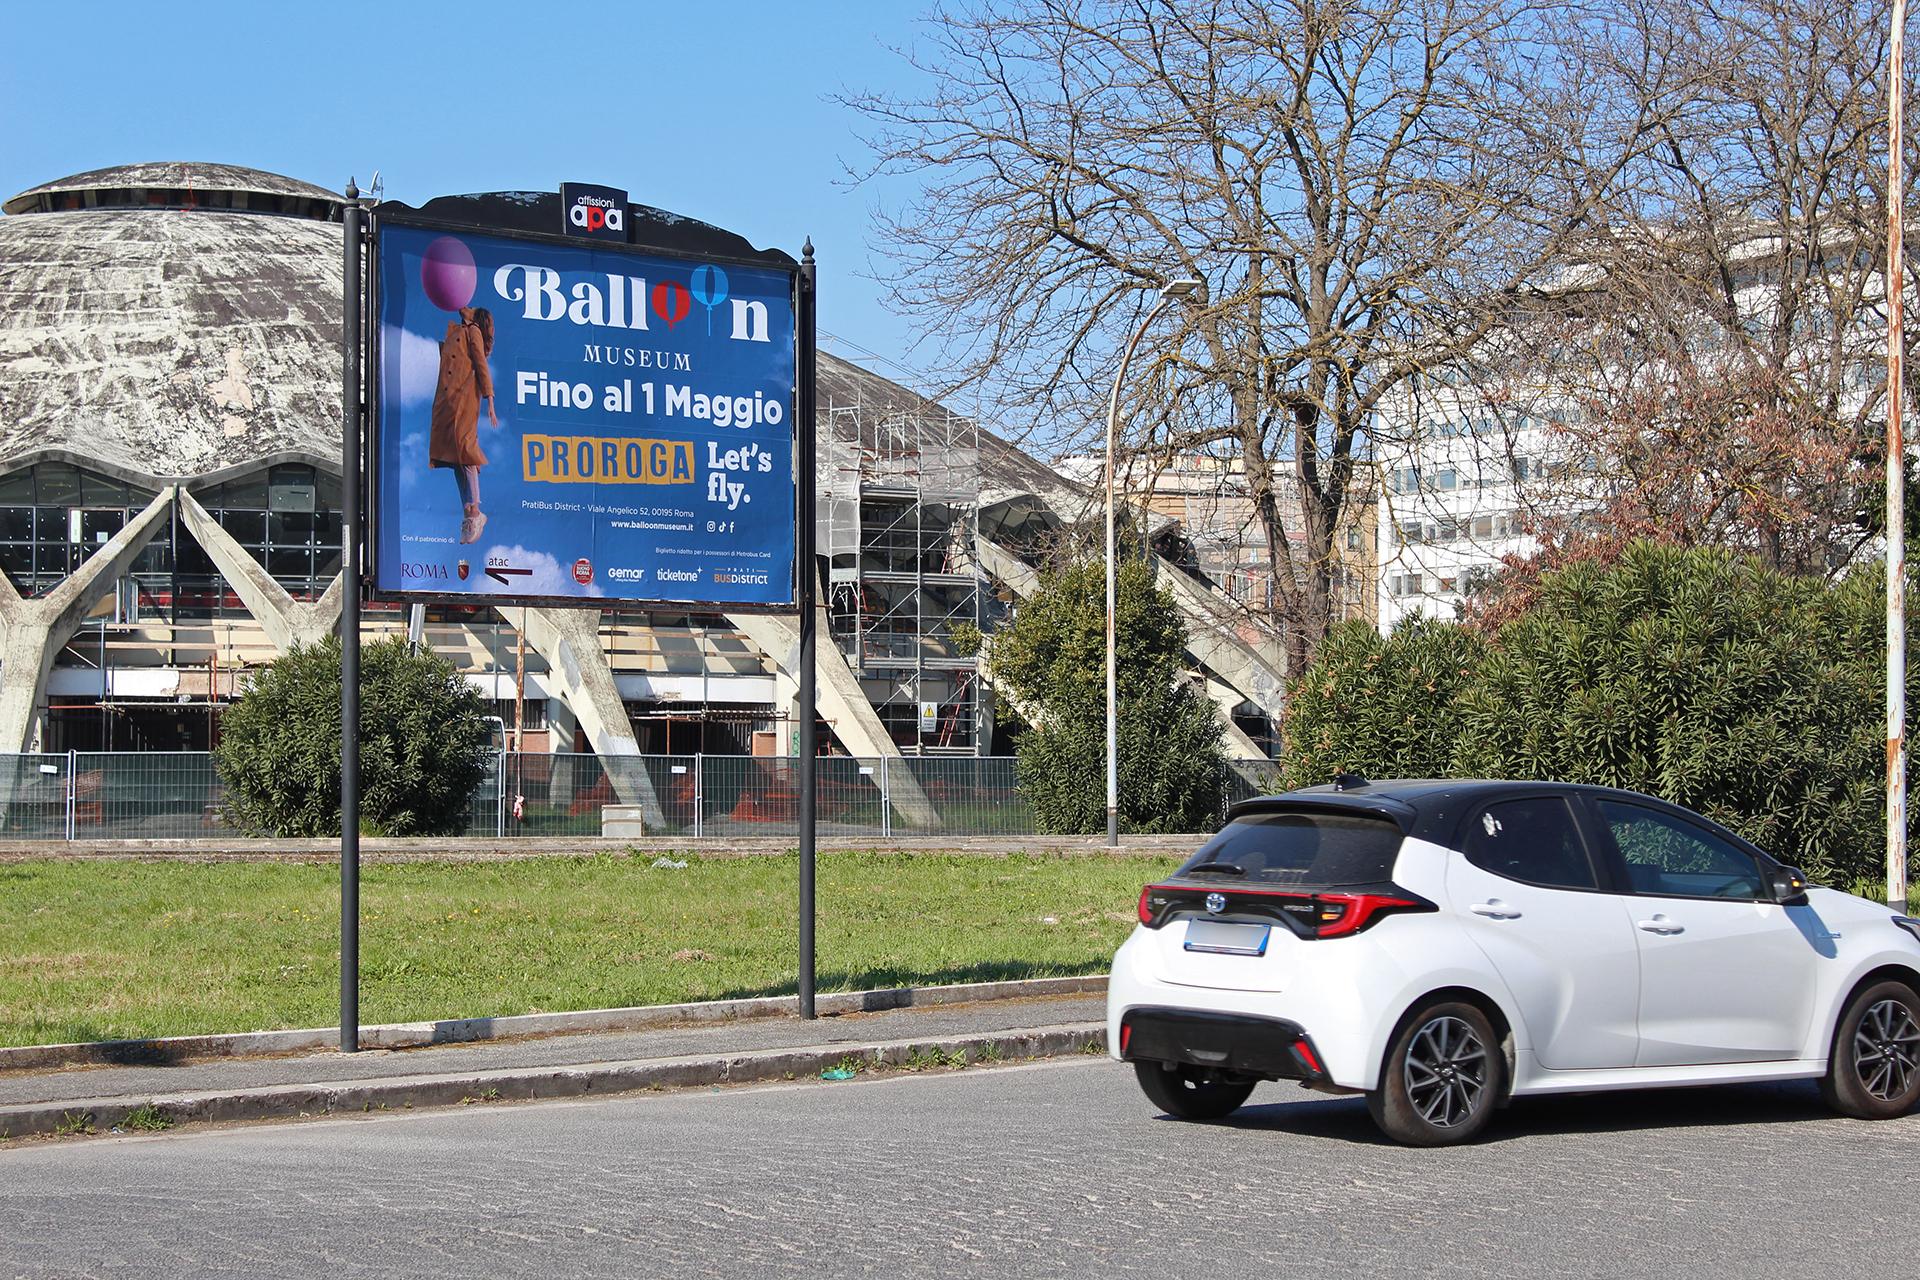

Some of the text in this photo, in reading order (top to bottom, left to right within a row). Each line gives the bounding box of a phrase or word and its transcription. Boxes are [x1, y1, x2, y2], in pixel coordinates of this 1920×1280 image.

[577, 196, 614, 208] affissioni
[570, 205, 622, 231] apa
[494, 264, 770, 342] Balloon
[584, 344, 691, 371] MUSEUM
[517, 372, 783, 428] Fino al 1 Maggio
[527, 441, 690, 479] PROROGA
[708, 472, 750, 510] fly.
[522, 500, 552, 510] PratiBus
[554, 502, 580, 512] District
[588, 504, 605, 513] Viale
[607, 506, 638, 516] Angelico
[652, 508, 672, 516] 00195
[674, 508, 694, 518] Roma
[611, 520, 694, 532] www.balloonmuseum.it
[401, 563, 448, 578] ROMA
[488, 557, 508, 567] atac
[657, 568, 698, 582] ticketone
